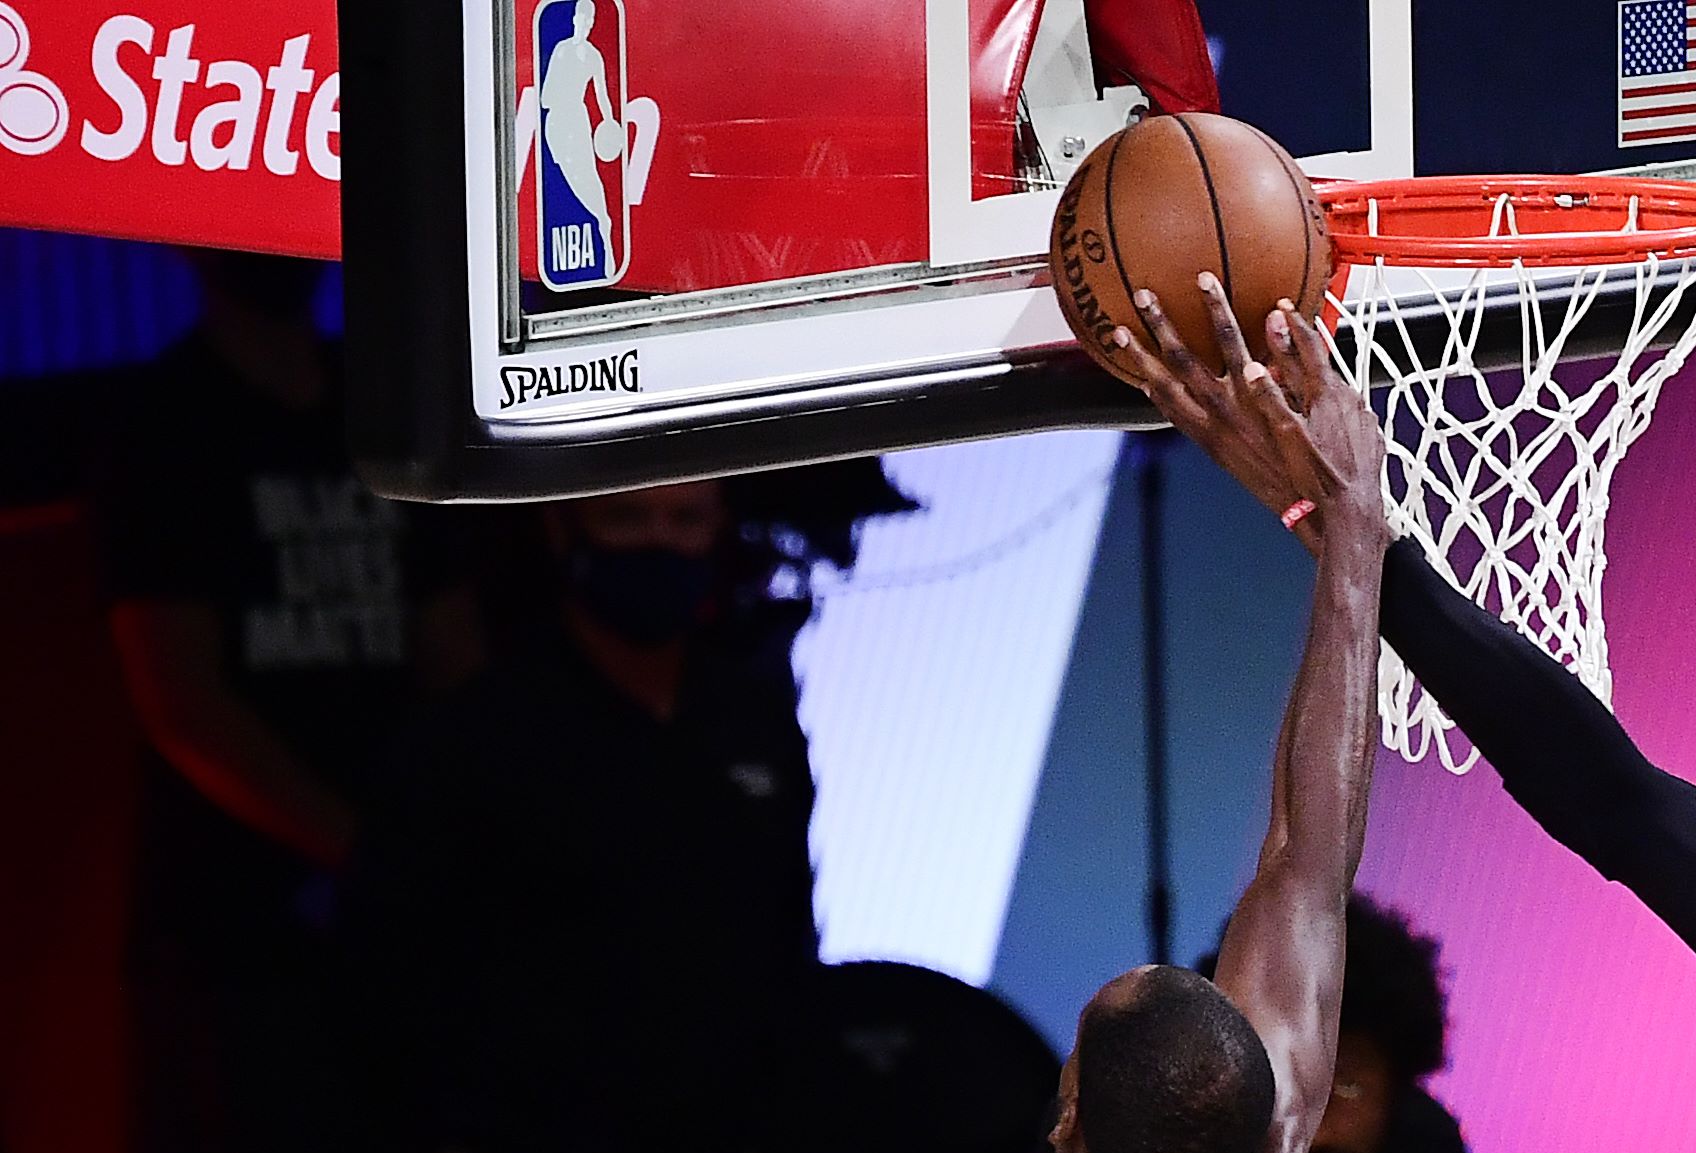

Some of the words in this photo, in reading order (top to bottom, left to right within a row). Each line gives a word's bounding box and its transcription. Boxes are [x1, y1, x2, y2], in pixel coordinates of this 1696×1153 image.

[81, 14, 341, 181] State
[551, 222, 595, 272] NBA
[500, 349, 638, 409] SPALDING
